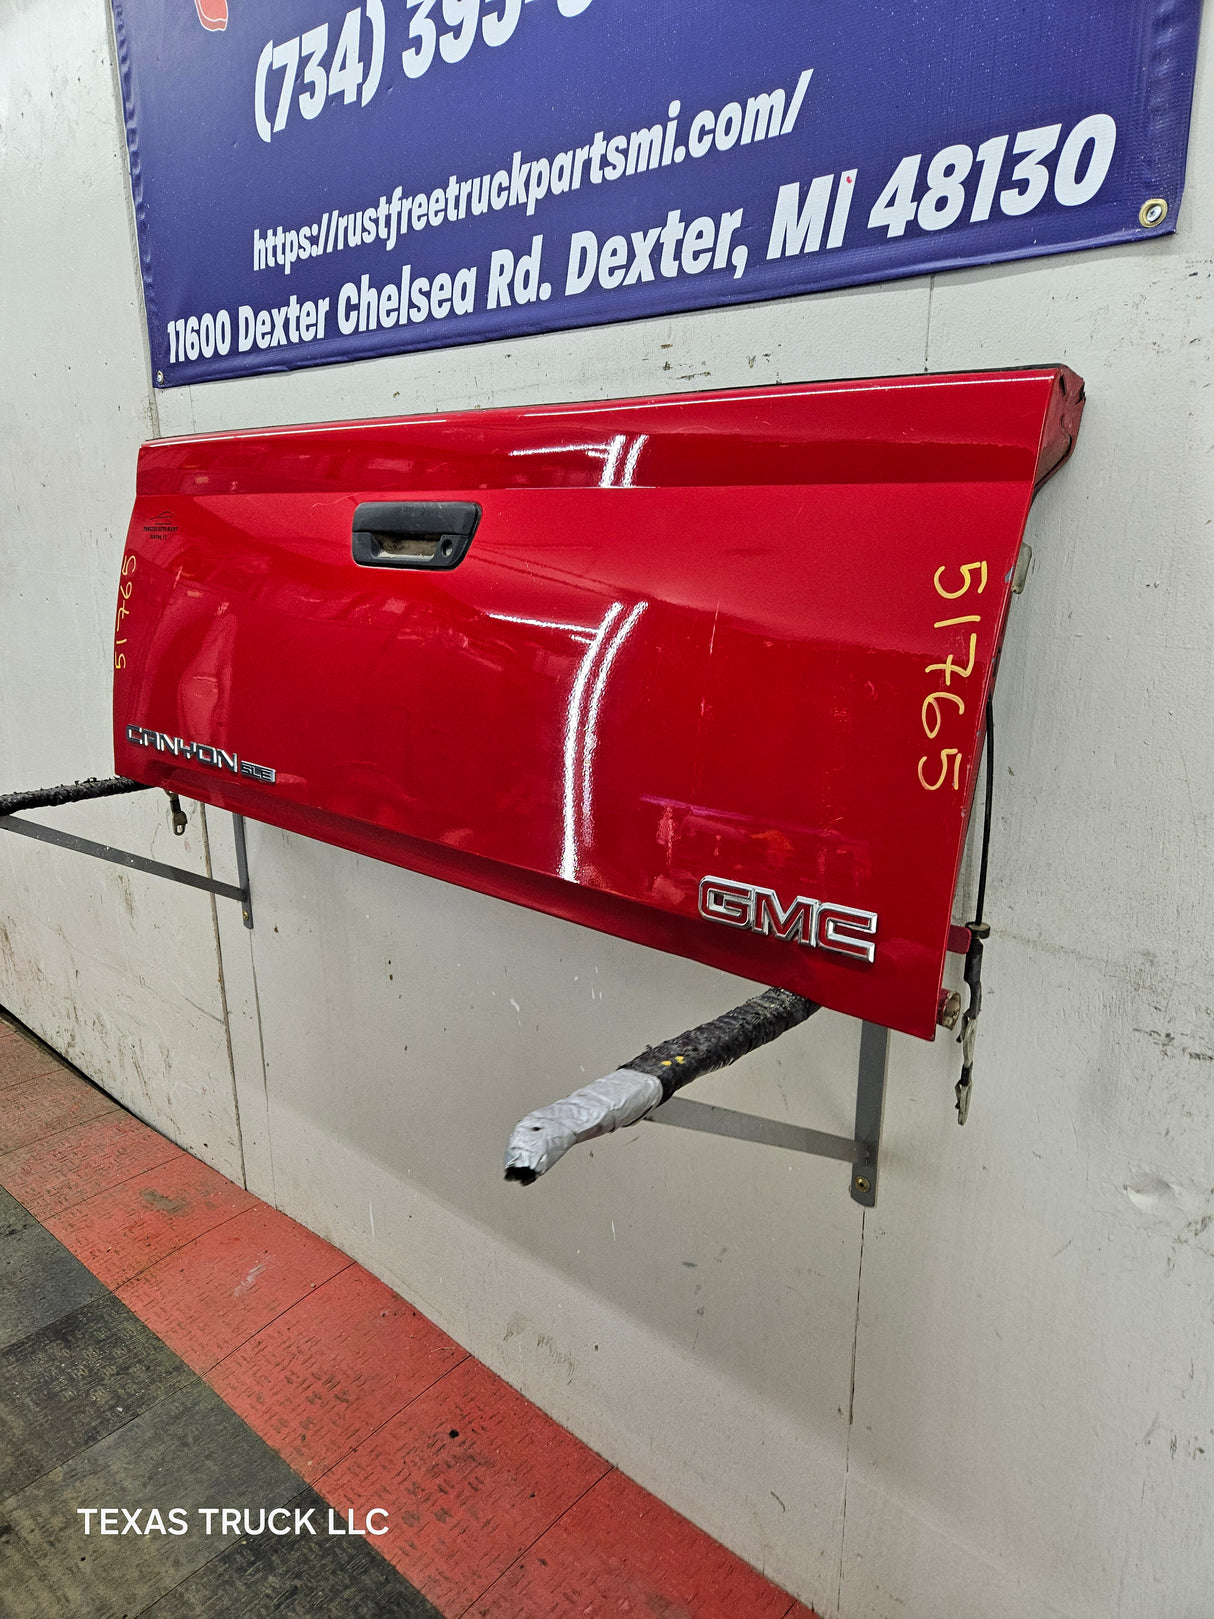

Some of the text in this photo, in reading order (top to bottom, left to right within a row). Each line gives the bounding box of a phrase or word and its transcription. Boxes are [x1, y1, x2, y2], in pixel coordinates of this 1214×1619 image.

[254, 0, 386, 143] (734)
[167, 113, 1117, 364] 11600 Dexter Chelsea Rd. Dexter, MI 48130
[253, 69, 814, 275] https://rustfreetruckpartsmi.com/
[114, 554, 137, 669] 51765
[917, 560, 988, 791] 51765
[126, 723, 276, 783] CANYON SLE
[699, 875, 878, 964] GMC
